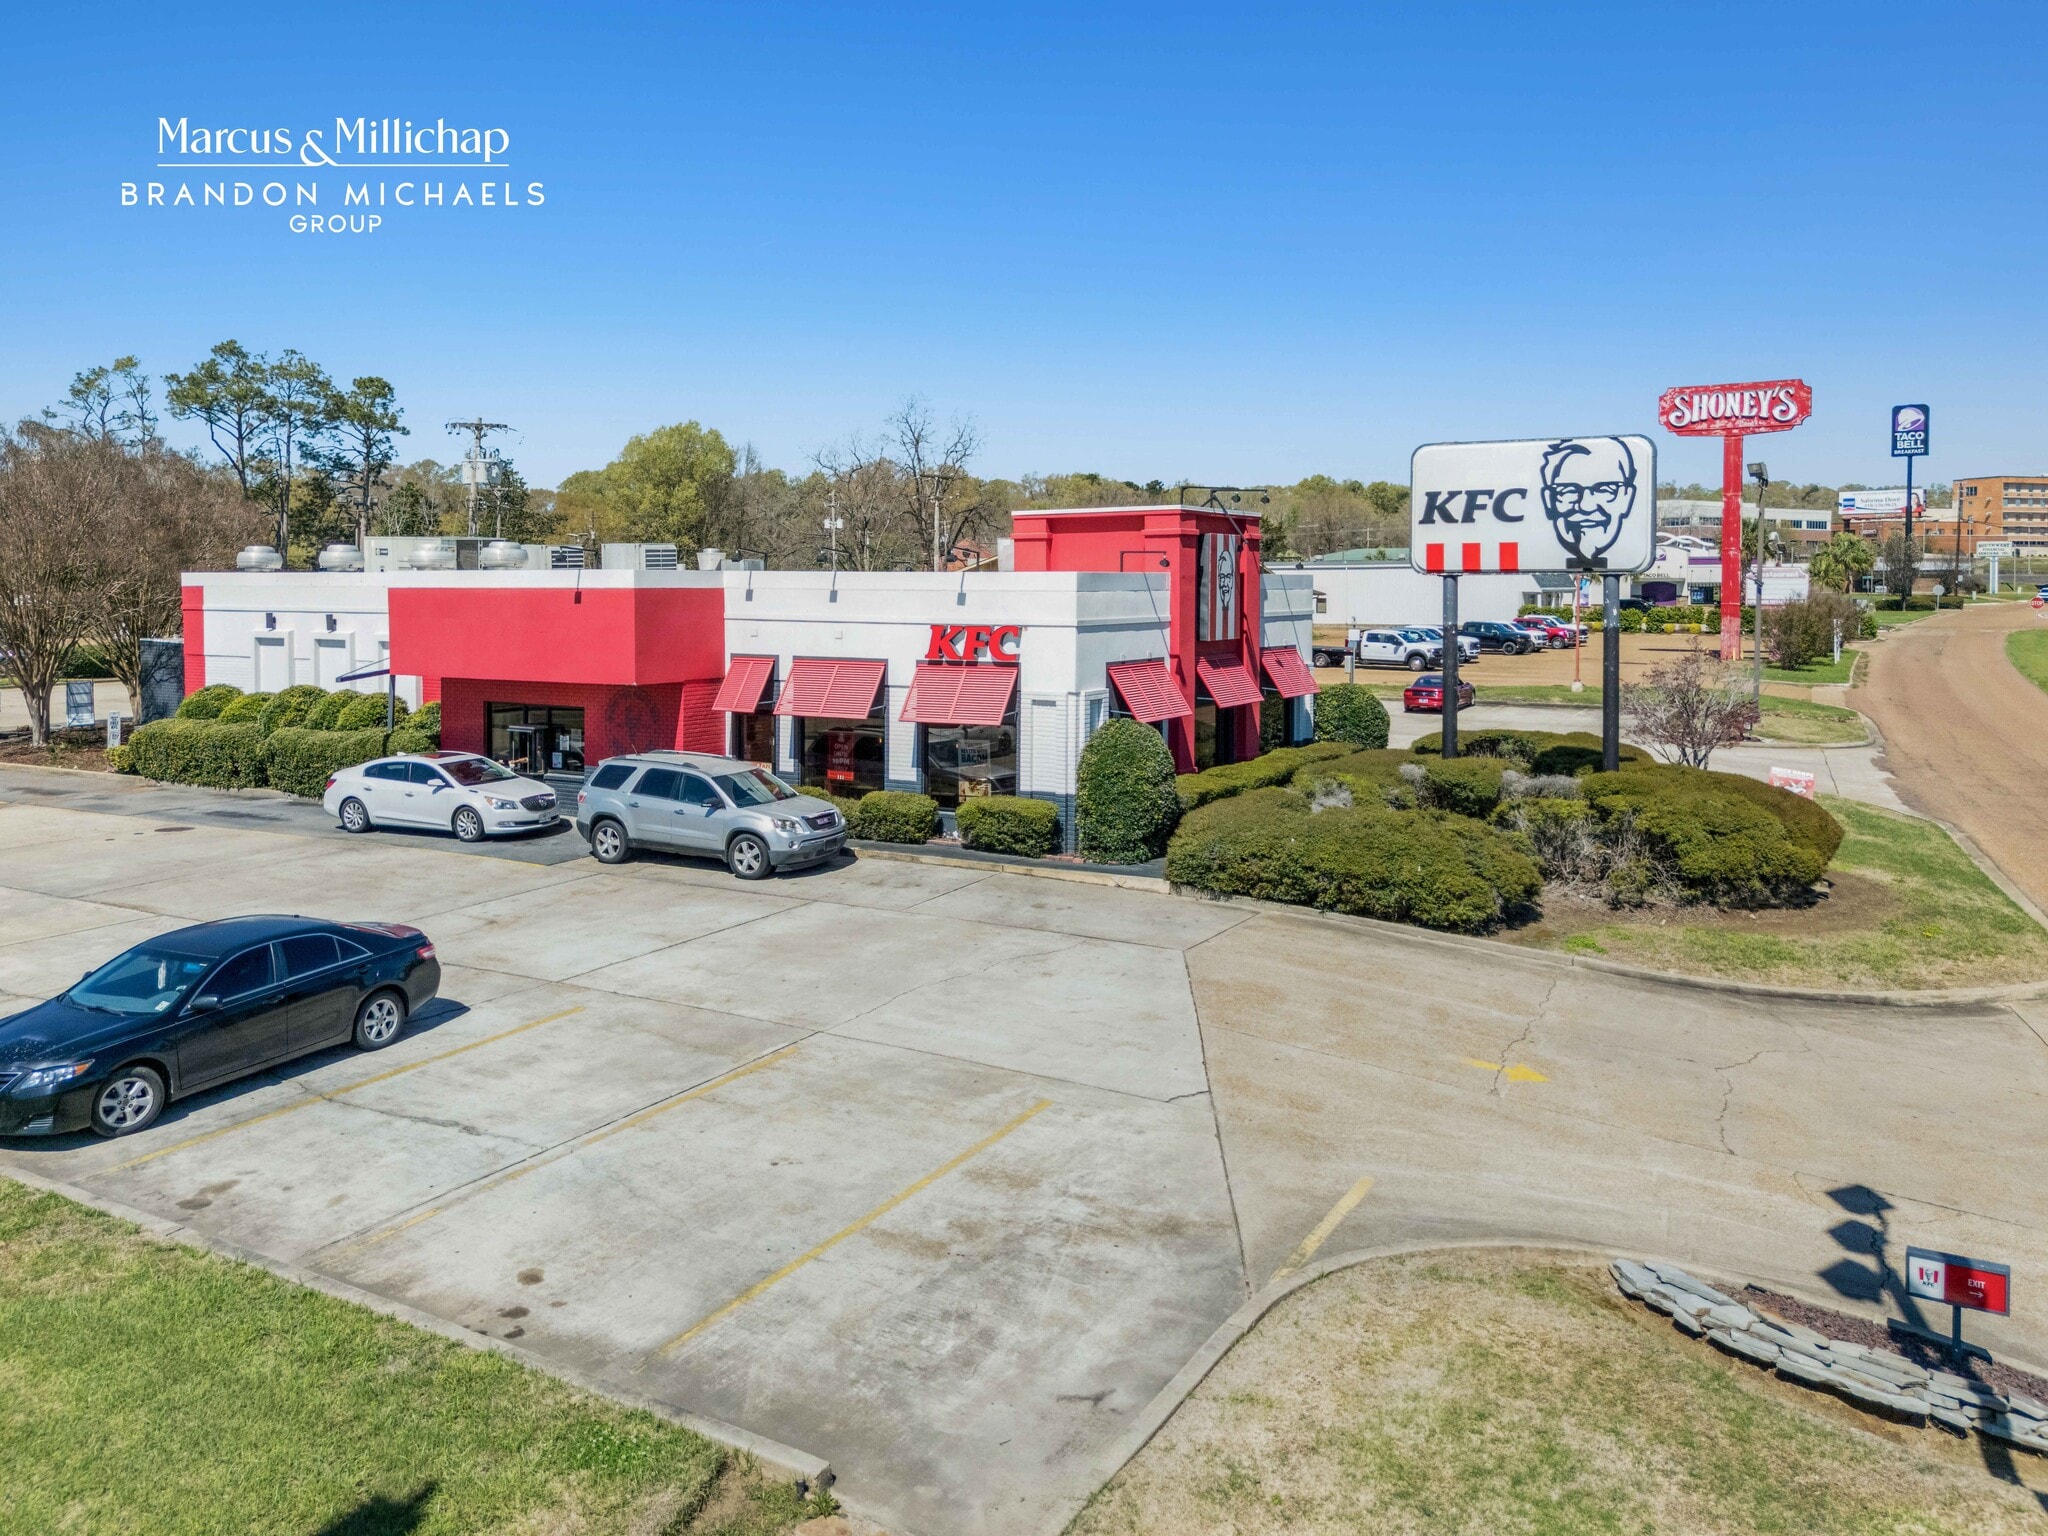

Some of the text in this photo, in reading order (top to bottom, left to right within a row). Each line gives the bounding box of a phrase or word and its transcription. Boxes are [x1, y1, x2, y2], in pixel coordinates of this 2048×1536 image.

[1668, 386, 1798, 428] SHONEY'S
[1894, 431, 1925, 441] TACO
[1896, 440, 1924, 449] BELL
[1418, 488, 1528, 524] KFC
[925, 624, 1019, 662] KFC
[960, 754, 989, 764] BACON
[1967, 1279, 1986, 1289] EXIT
